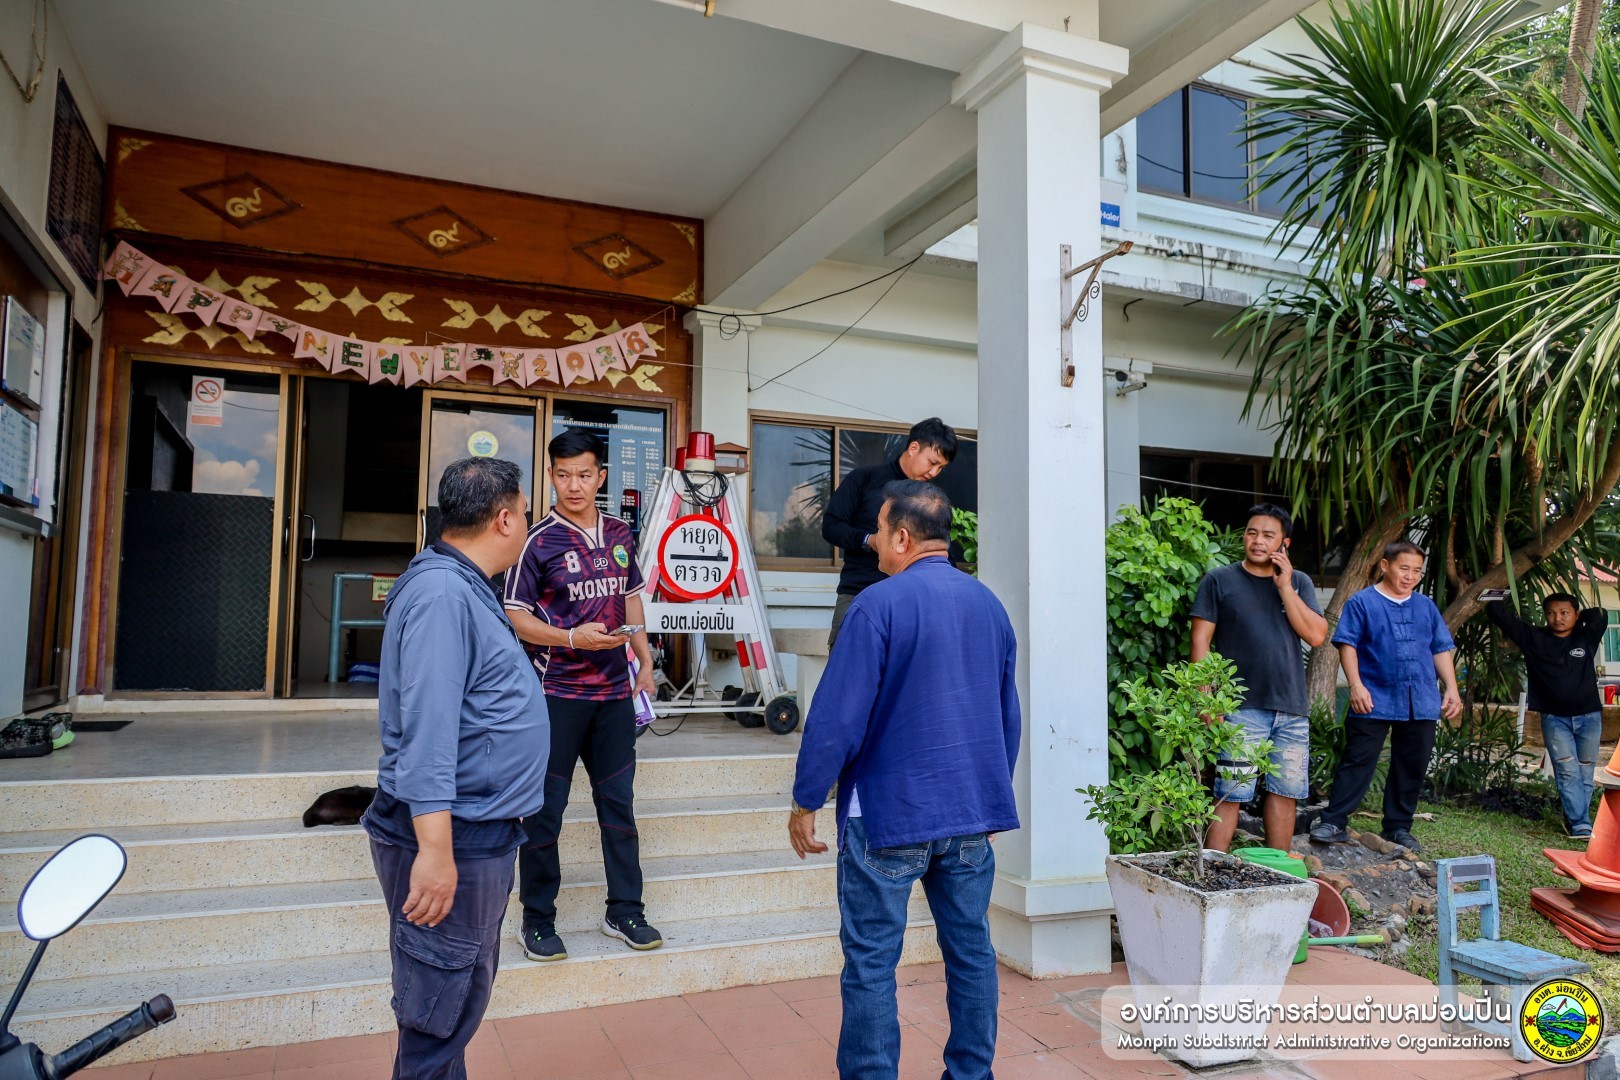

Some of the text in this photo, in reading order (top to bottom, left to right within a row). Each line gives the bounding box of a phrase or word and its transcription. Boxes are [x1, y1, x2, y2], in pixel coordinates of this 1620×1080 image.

[303, 331, 399, 376] NEW
[410, 347, 523, 379] YEAR
[531, 331, 649, 378] 2026
[680, 526, 719, 553] หยุด
[565, 551, 580, 573] 8
[594, 557, 609, 568] PD
[674, 564, 722, 583] ตรวจ
[661, 608, 734, 631] อบต.ม่อนปิ่น
